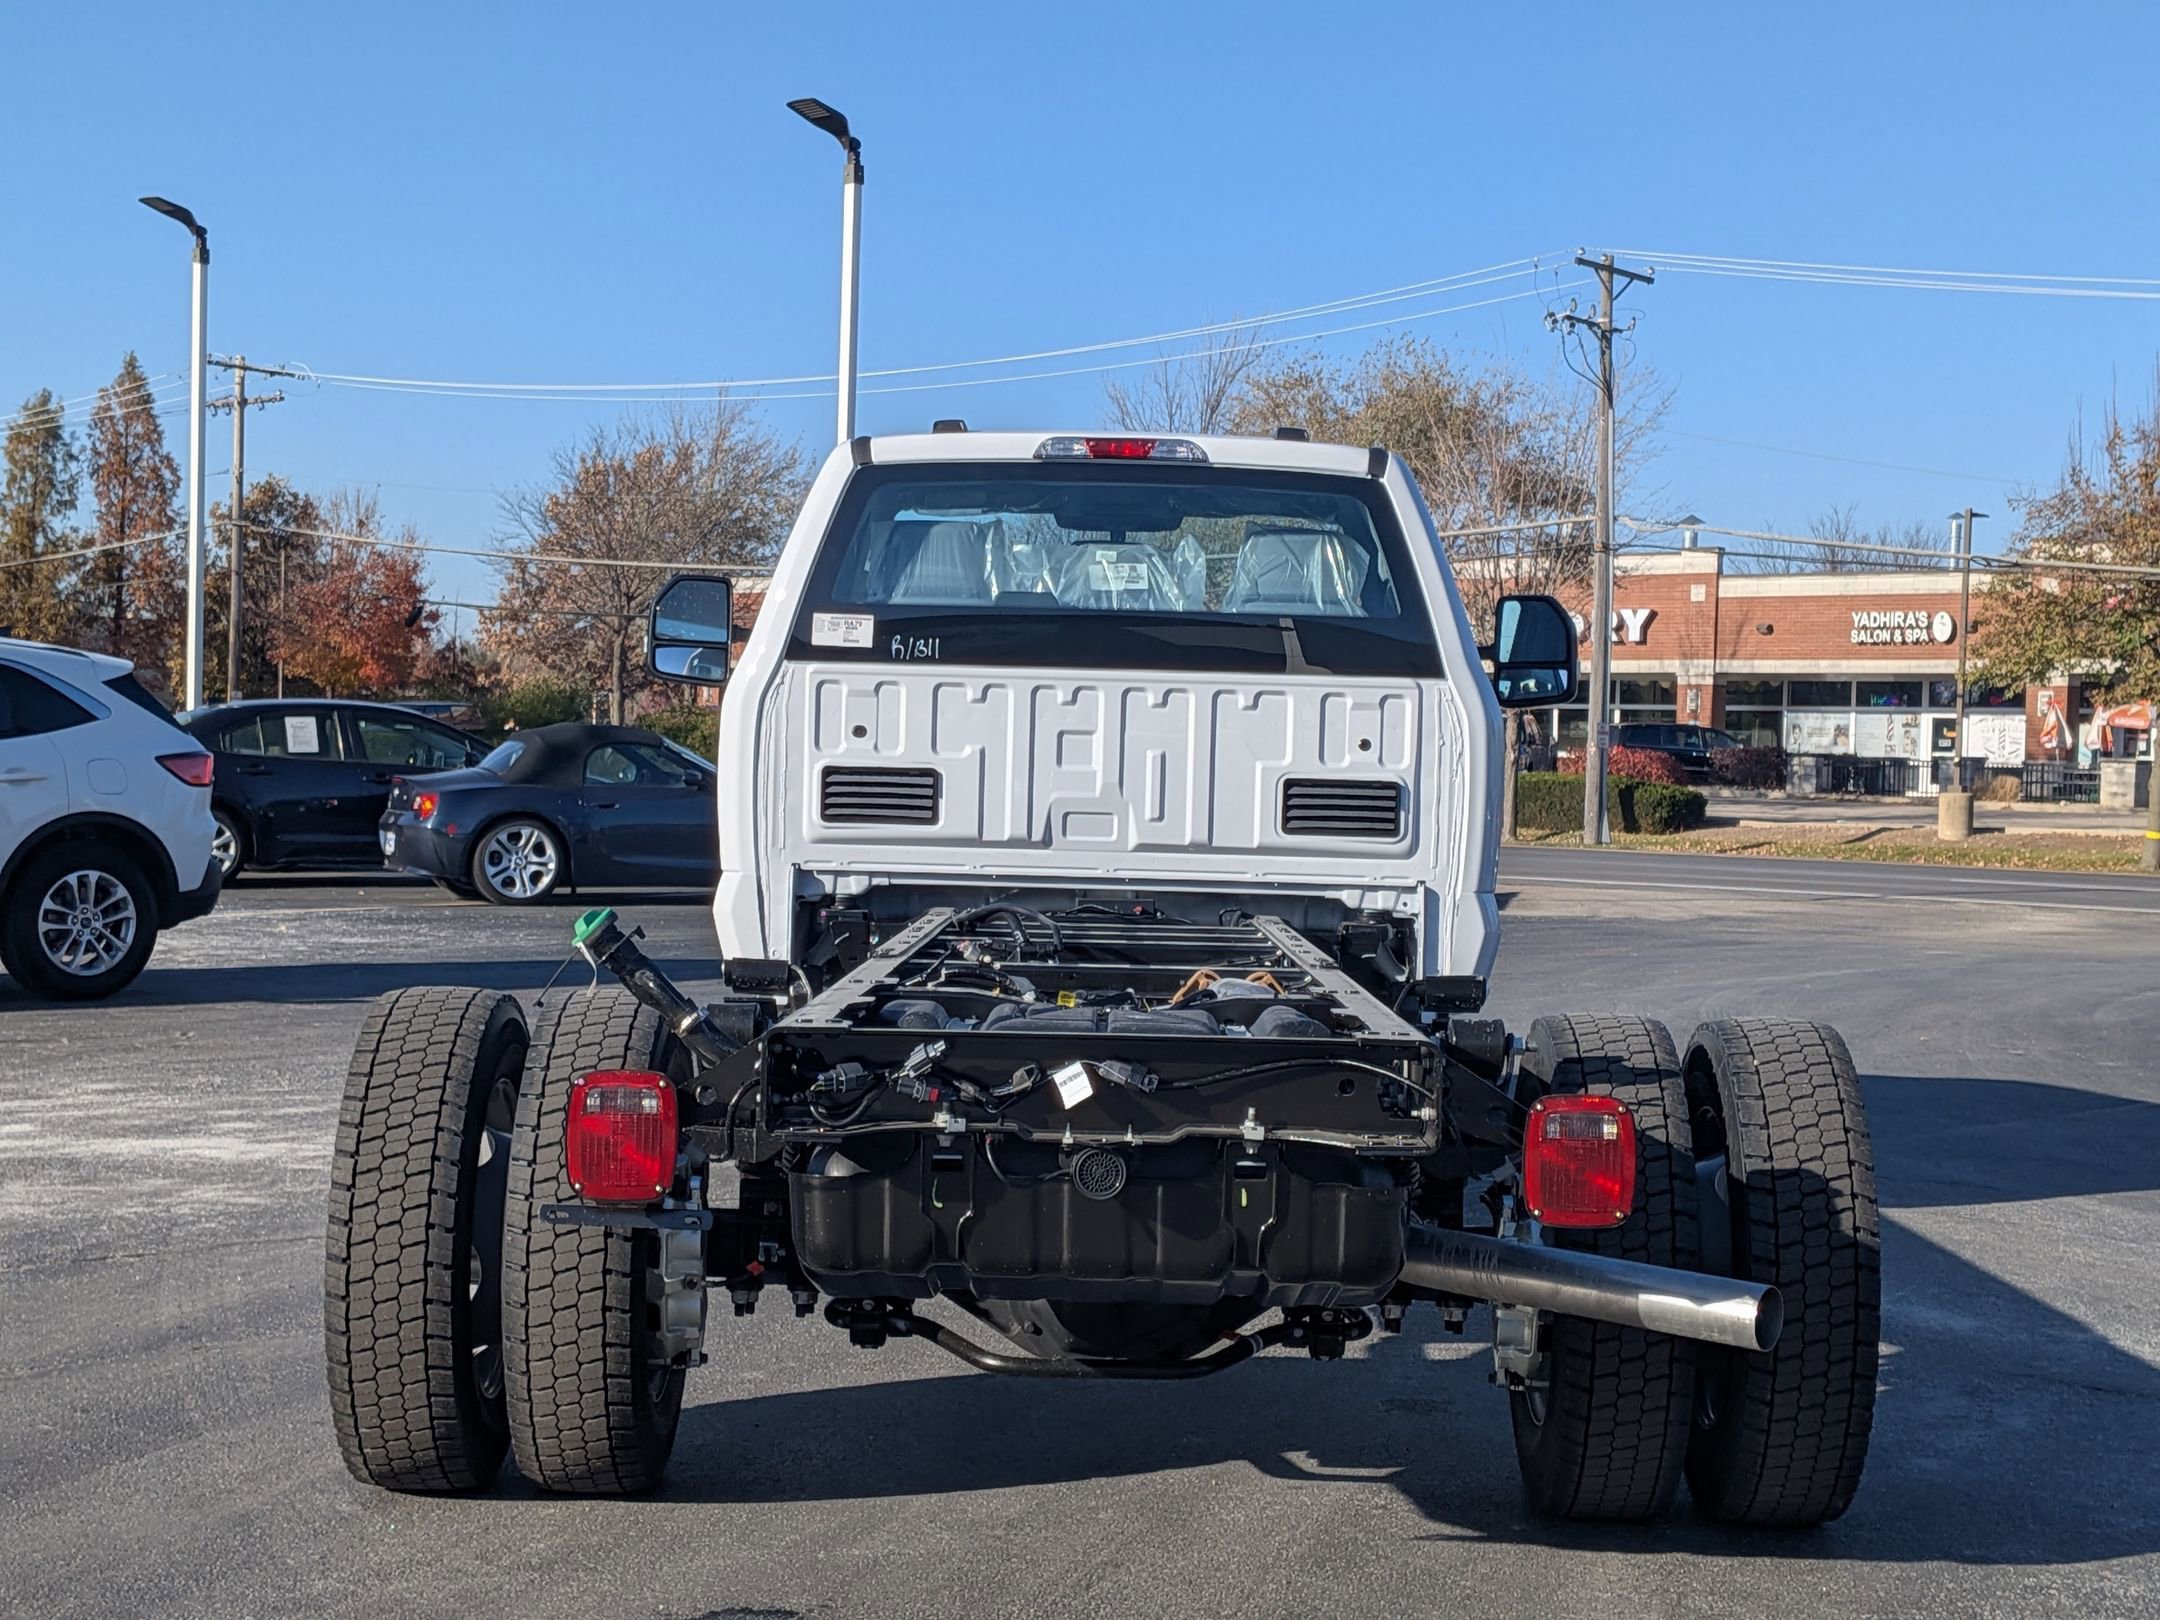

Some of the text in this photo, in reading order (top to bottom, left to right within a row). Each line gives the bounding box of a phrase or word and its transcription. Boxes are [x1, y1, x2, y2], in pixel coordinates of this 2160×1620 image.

[1851, 611, 1929, 628] YADHIRA'S
[1850, 628, 1929, 643] SALON & SPA
